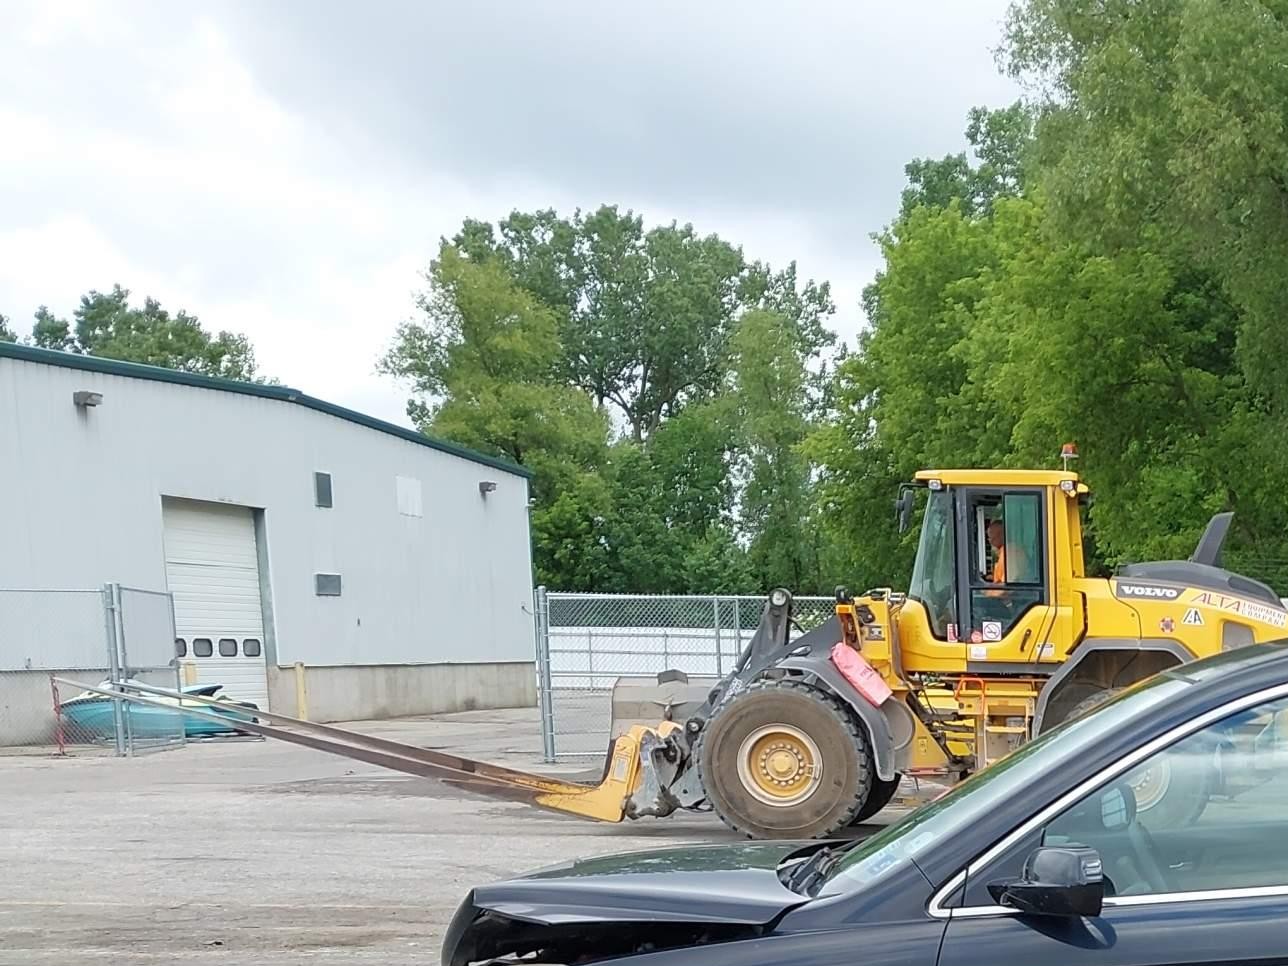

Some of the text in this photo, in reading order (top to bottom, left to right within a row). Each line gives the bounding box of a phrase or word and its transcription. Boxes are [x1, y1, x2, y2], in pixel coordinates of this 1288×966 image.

[1120, 585, 1178, 598] VOLVO
[1191, 592, 1241, 612] ALTA
[1242, 601, 1287, 620] EQUIPMENT
[1241, 608, 1286, 626] COMPANY
